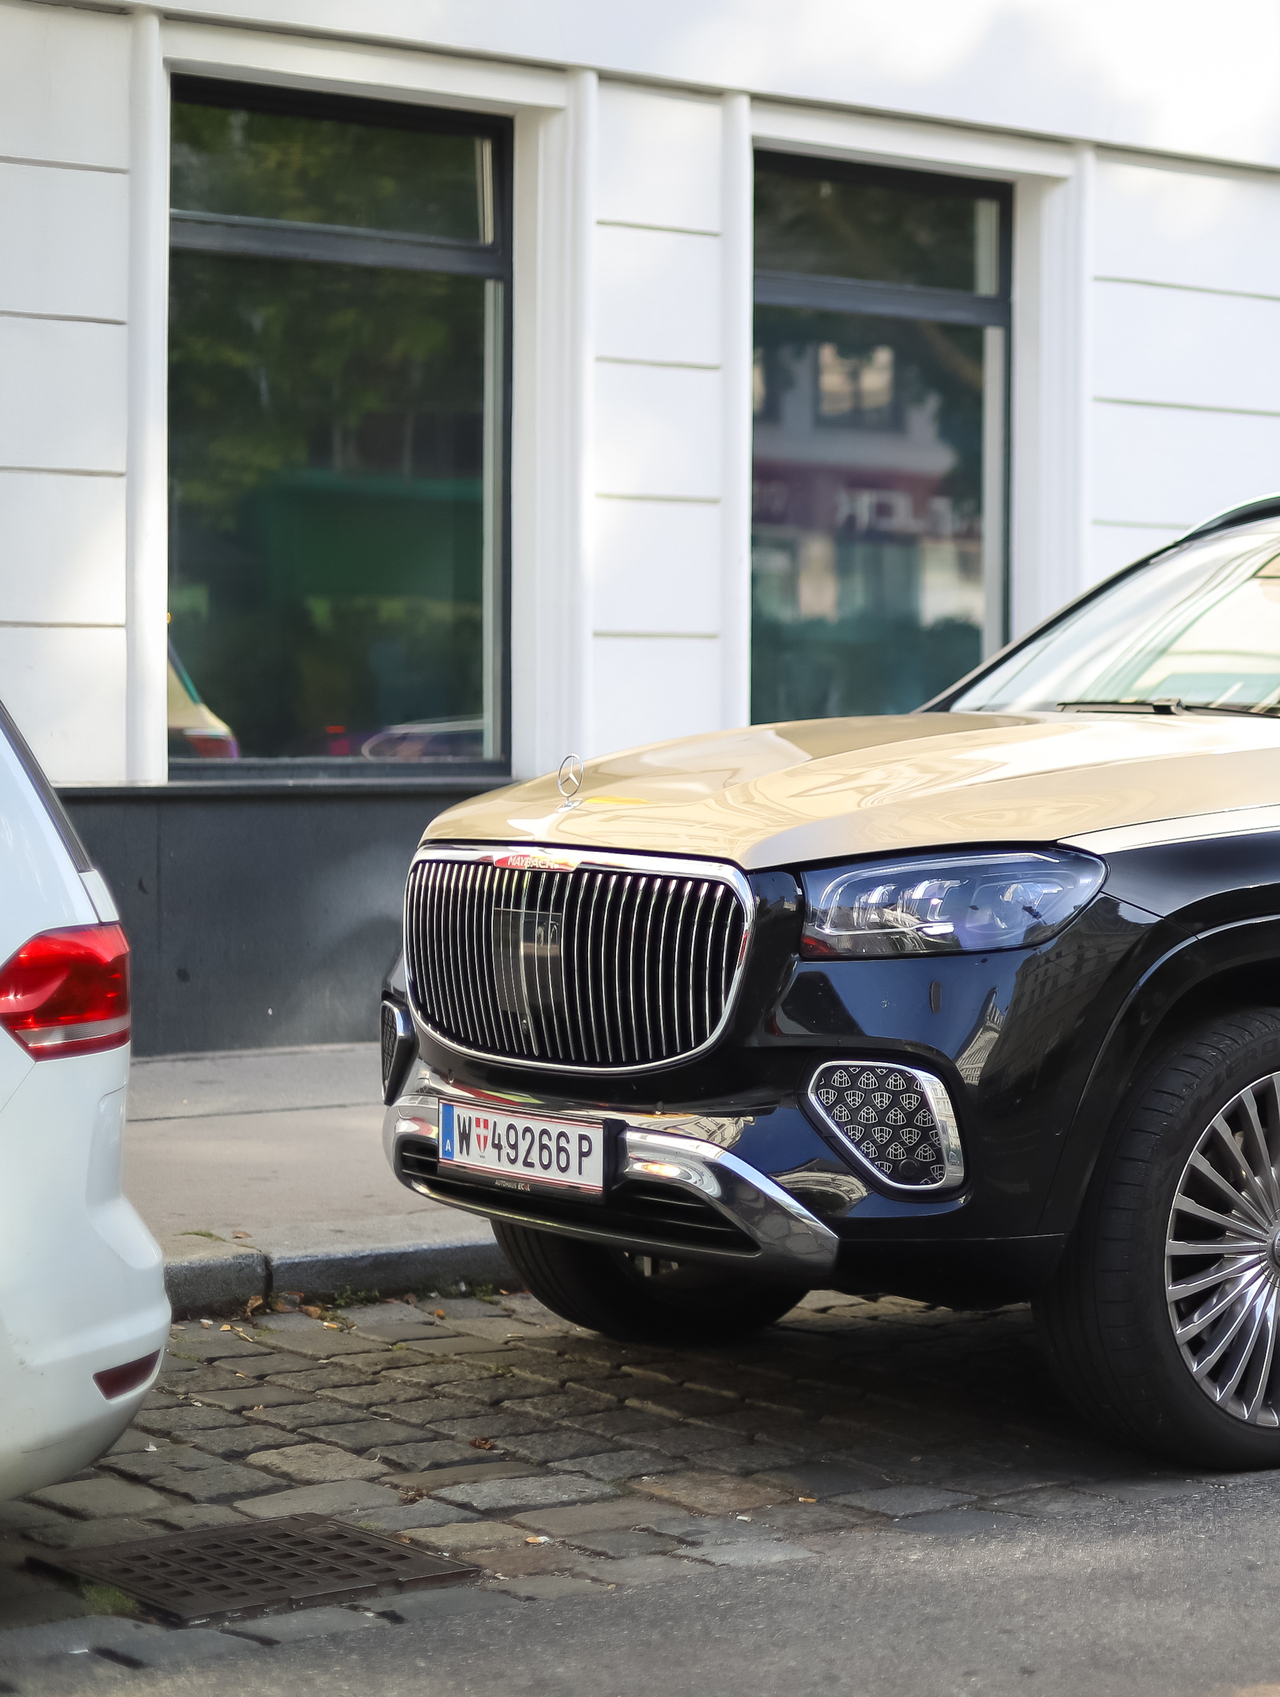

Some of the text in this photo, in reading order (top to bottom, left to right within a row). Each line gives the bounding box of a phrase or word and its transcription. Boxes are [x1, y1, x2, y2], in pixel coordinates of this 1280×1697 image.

[507, 855, 555, 869] MAYBACH
[445, 1139, 452, 1153] A
[491, 1119, 571, 1174] 49266
